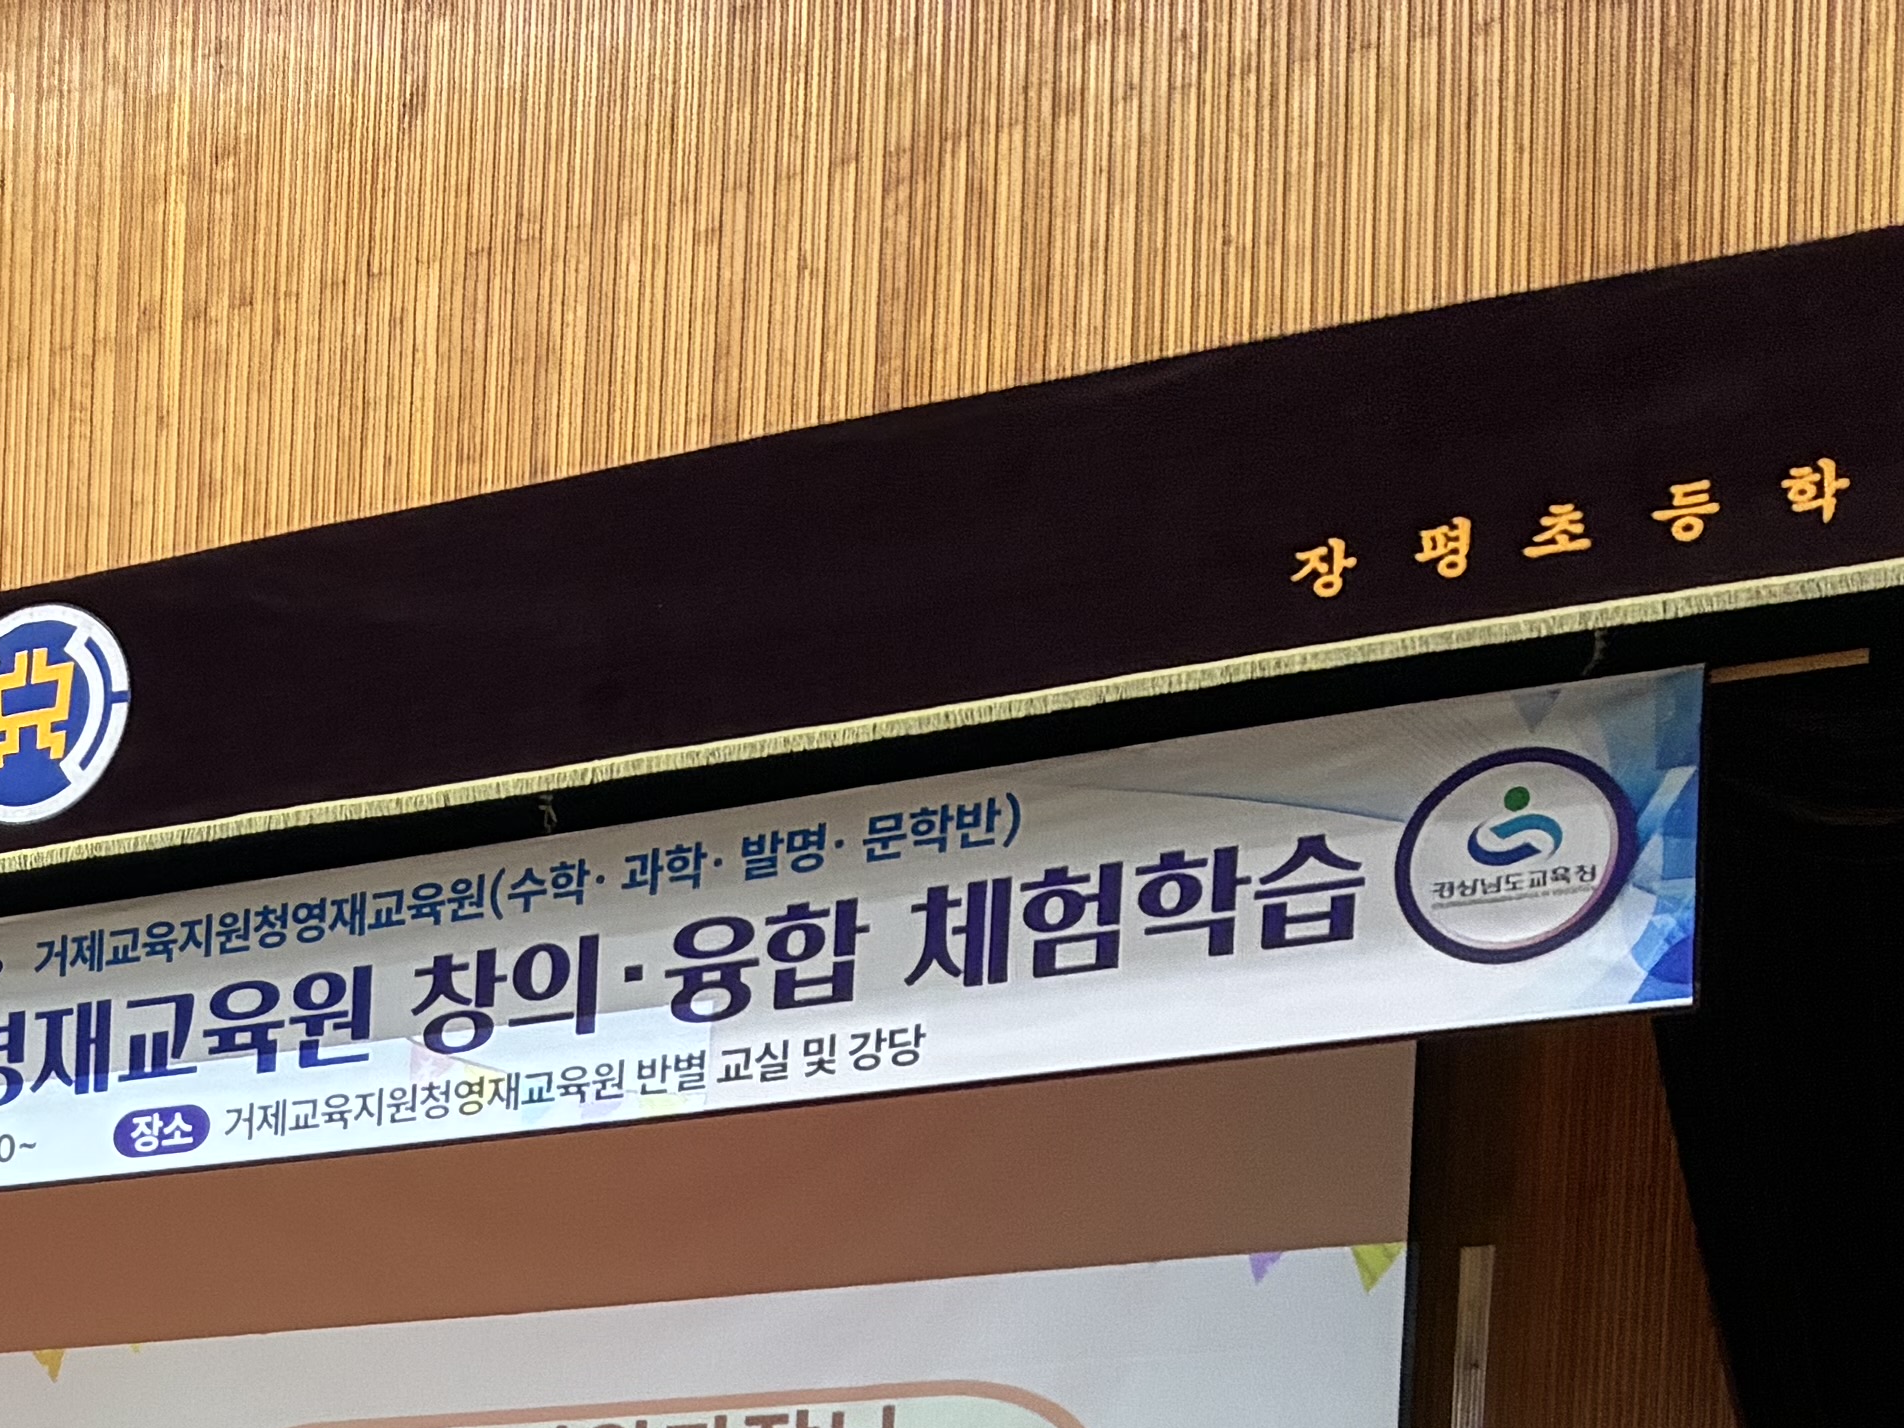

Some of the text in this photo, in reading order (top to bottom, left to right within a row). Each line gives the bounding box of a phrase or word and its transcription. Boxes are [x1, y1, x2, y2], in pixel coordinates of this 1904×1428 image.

[862, 792, 1022, 864] 문학반)
[903, 833, 1367, 990] 체험학습
[130, 1023, 927, 1150] 장소 거제교육지원청영재교육원 반별 교실 및 강당
